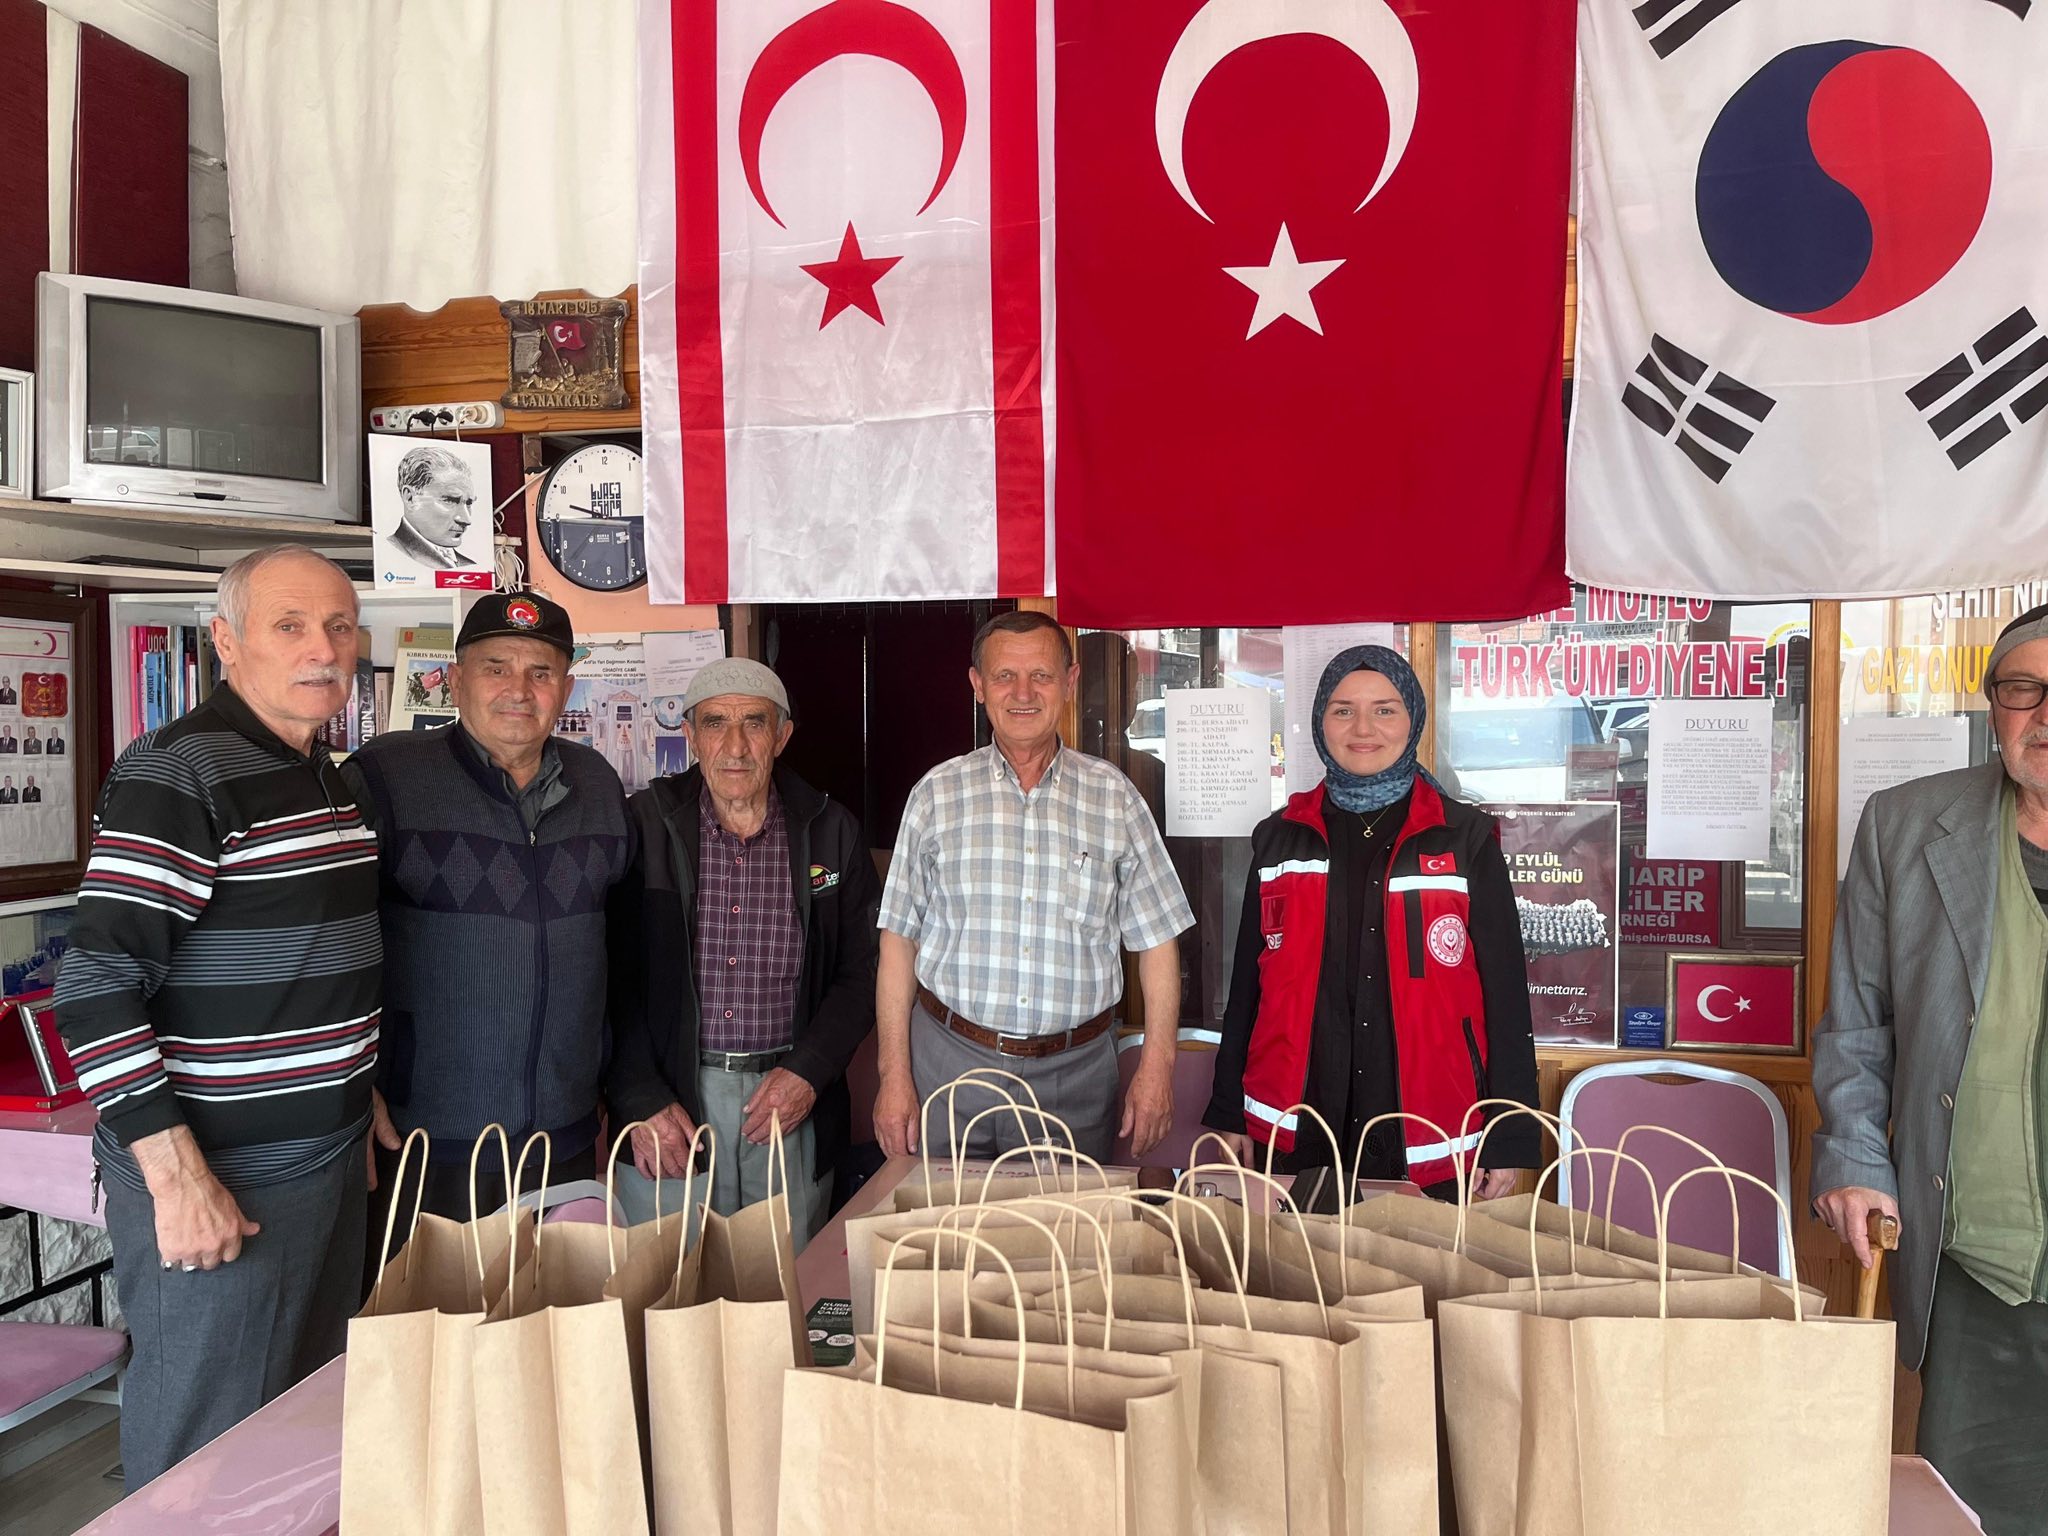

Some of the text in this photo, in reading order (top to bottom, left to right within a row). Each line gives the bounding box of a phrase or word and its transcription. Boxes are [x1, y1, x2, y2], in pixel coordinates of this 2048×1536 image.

[523, 301, 598, 315] 18 MART 1915
[601, 456, 608, 465] 12
[560, 485, 567, 494] 10
[563, 540, 568, 549] 8
[581, 559, 586, 568] 7
[630, 558, 636, 567] 5
[606, 566, 611, 575] 6
[1627, 630, 1766, 698] DİYENE
[1862, 636, 1921, 695] GAZİ
[1190, 703, 1245, 715] DUYURU
[1684, 718, 1750, 730] DUYURU
[1515, 851, 1562, 867] EYLÜL
[1508, 867, 1583, 884] LER GÜNÜ
[1620, 911, 1676, 928] RNEĞİ
[1618, 933, 1711, 945] enişehir/BURSA
[1527, 982, 1588, 996] innettarız.
